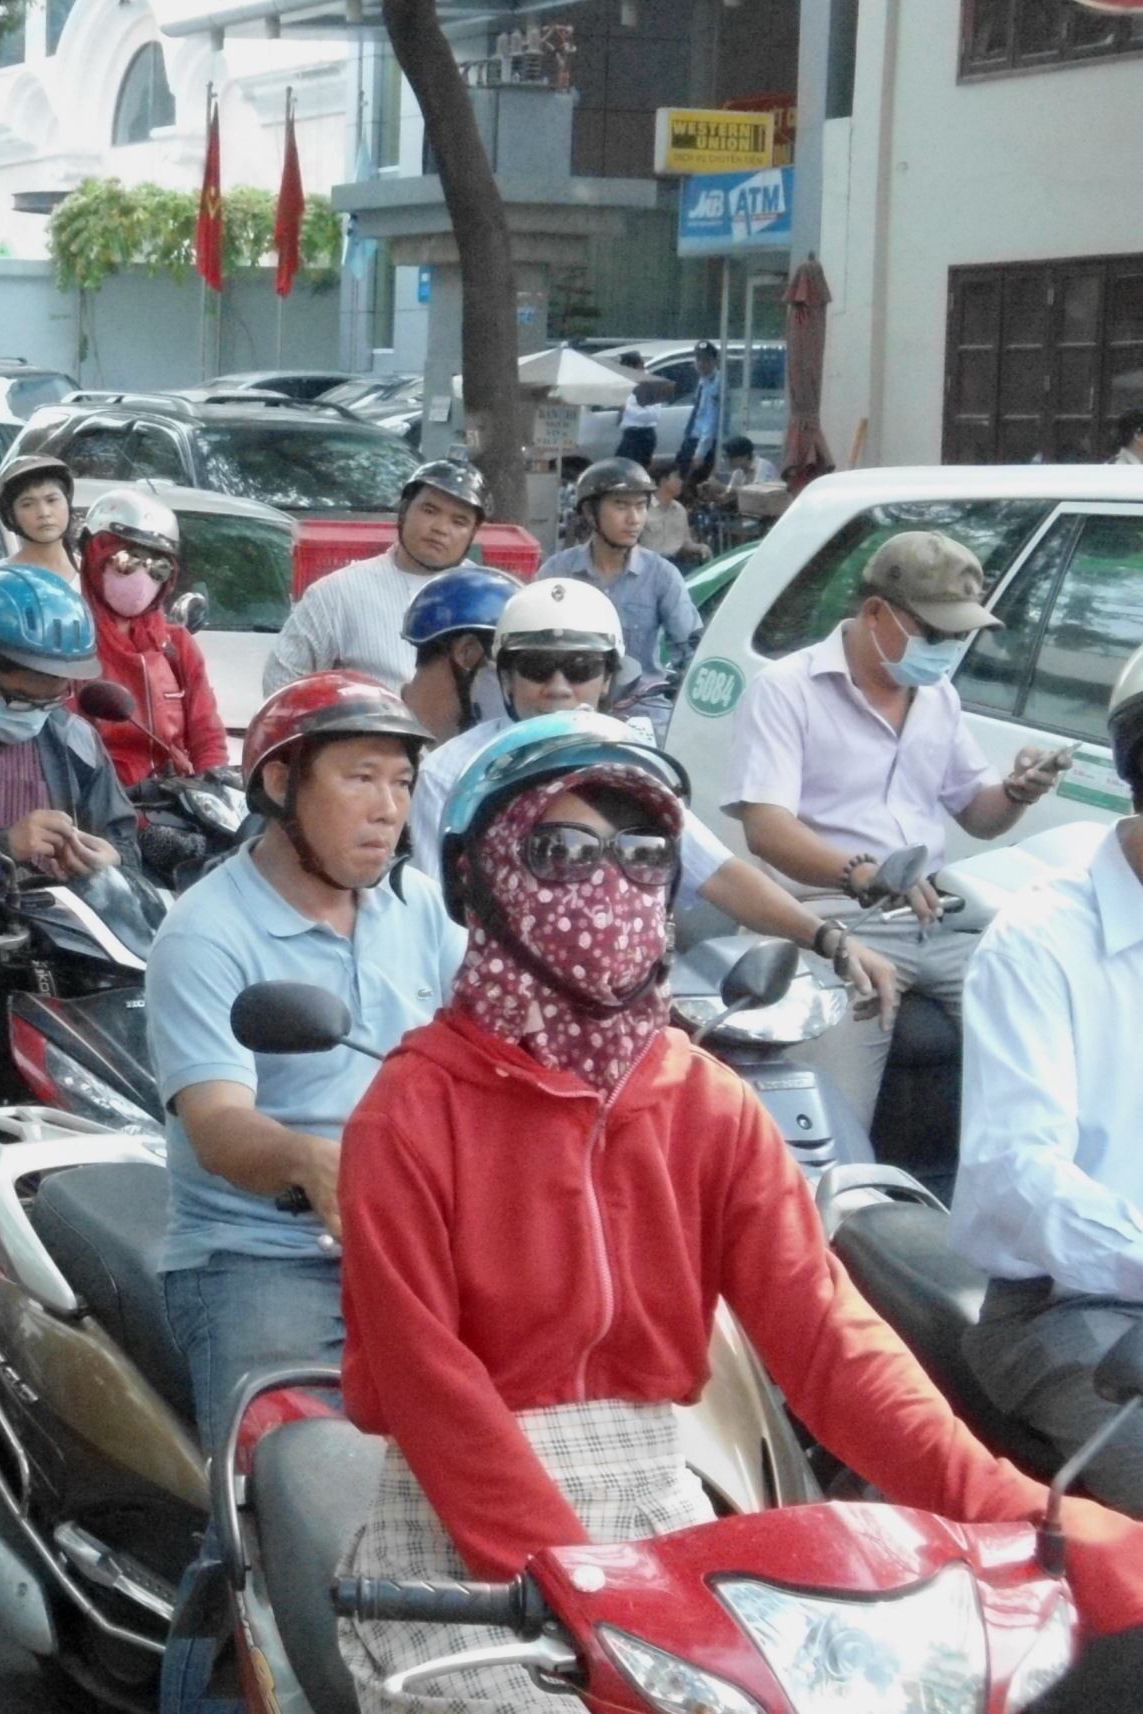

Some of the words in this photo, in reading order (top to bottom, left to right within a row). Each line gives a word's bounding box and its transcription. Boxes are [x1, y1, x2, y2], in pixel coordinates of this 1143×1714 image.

[672, 120, 750, 137] WESTERN
[696, 136, 750, 151] UNION
[734, 184, 780, 230] ATM
[692, 666, 736, 708] 5084
